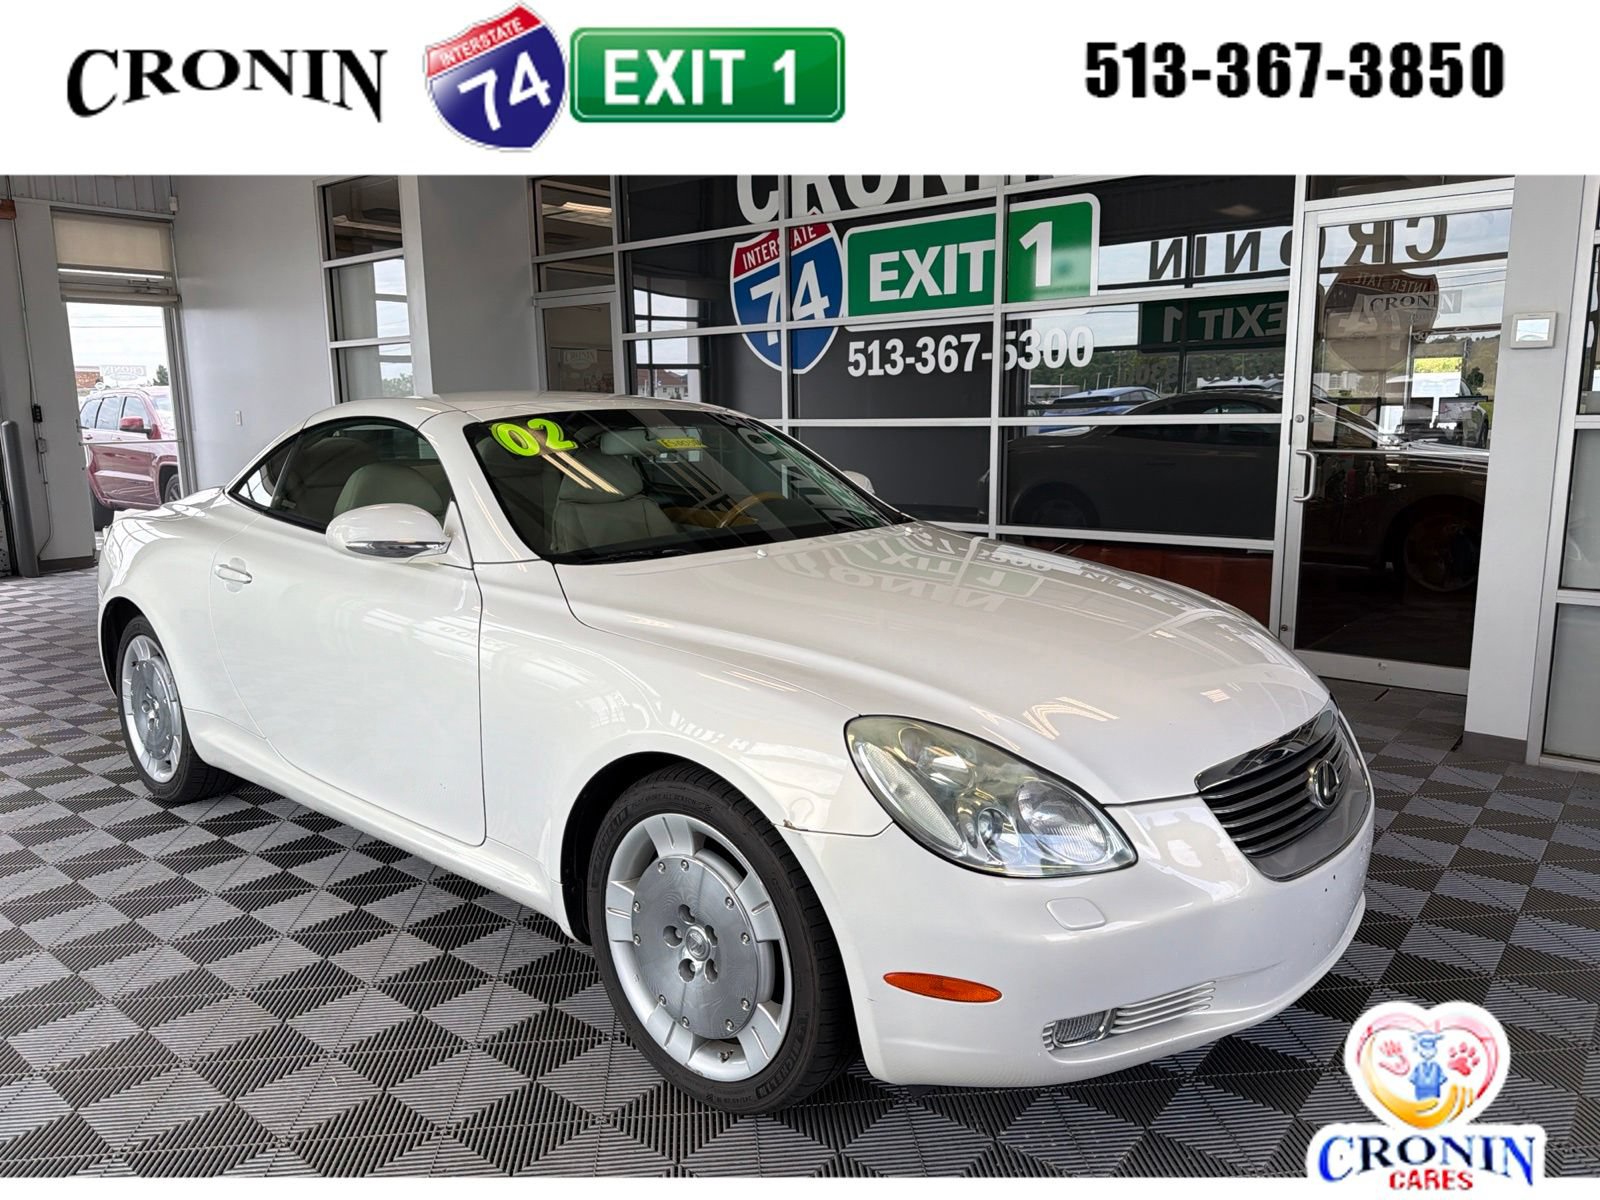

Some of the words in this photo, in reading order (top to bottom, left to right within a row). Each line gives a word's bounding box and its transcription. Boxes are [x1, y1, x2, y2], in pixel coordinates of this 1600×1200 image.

[743, 226, 816, 270] INTERATE
[870, 239, 995, 302] EXIT
[1019, 221, 1053, 287] 1
[750, 260, 830, 346] 74
[1370, 293, 1455, 312] CRONIN
[848, 326, 1094, 377] 513-367-5300
[489, 418, 578, 457] 02
